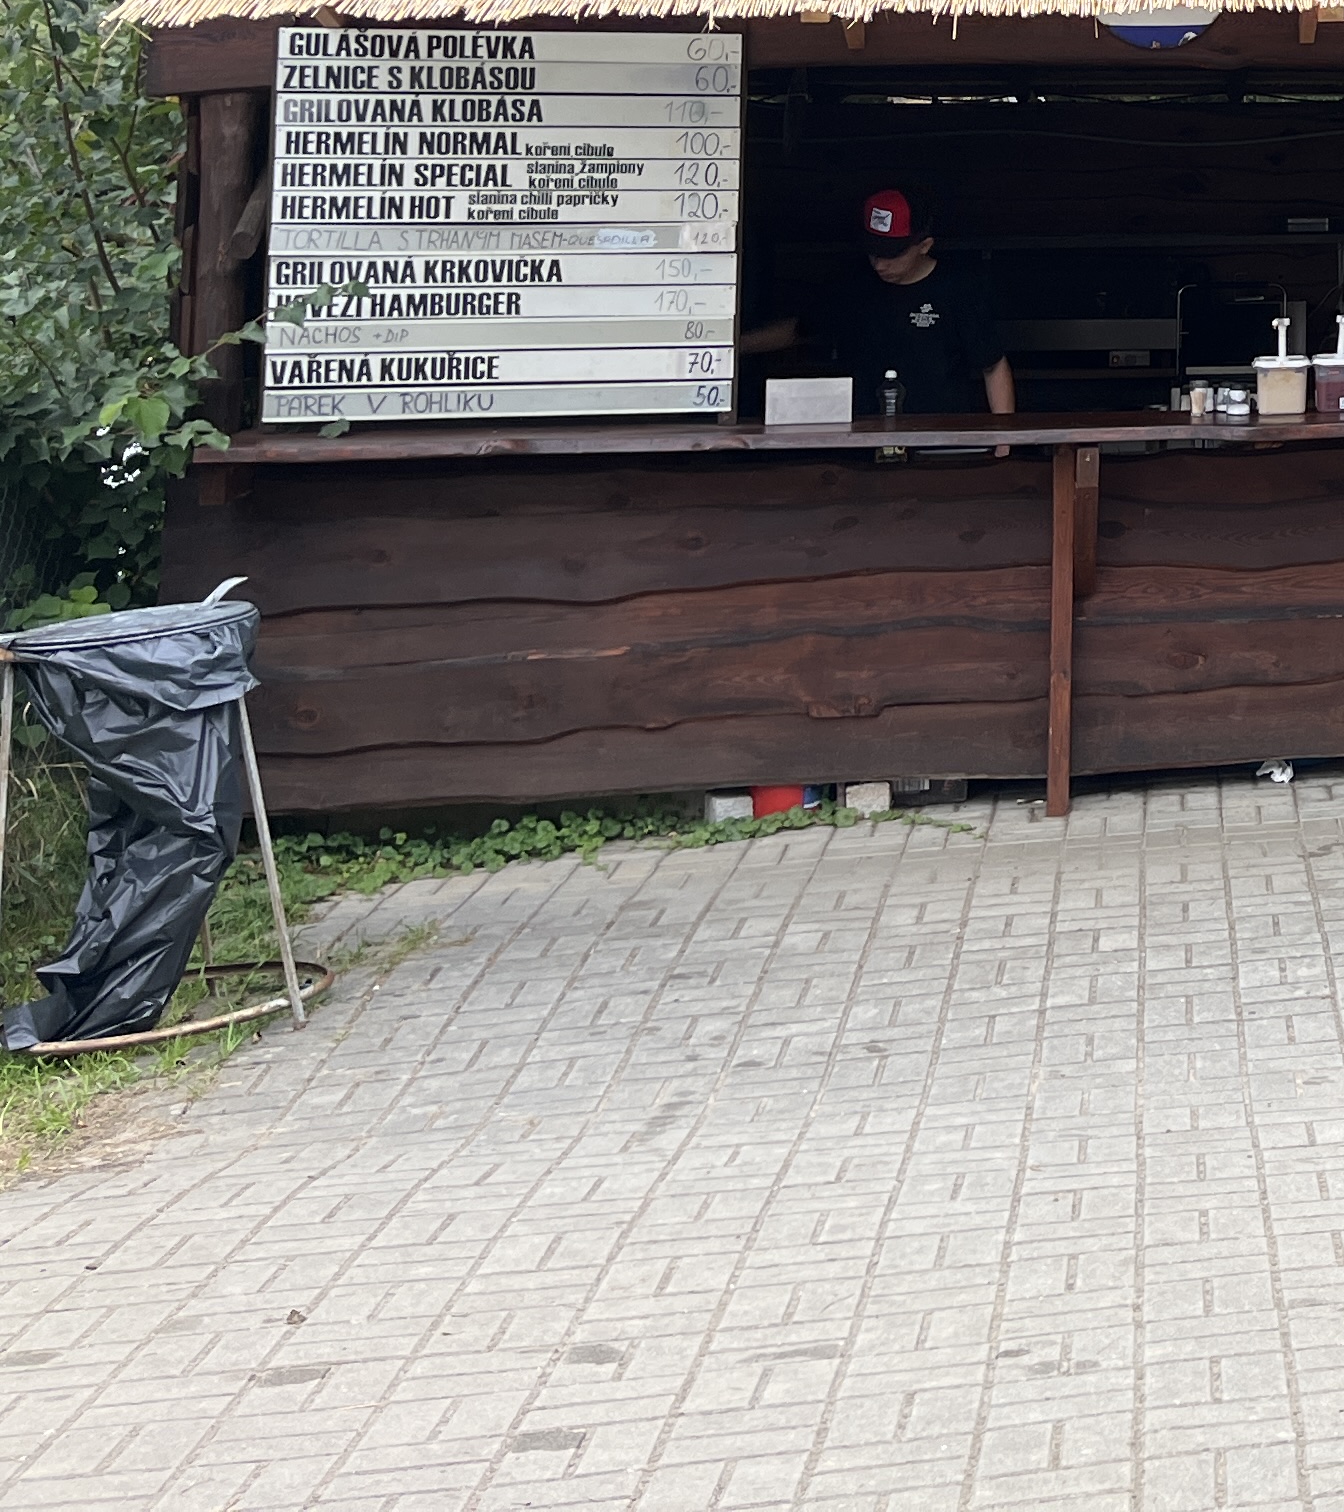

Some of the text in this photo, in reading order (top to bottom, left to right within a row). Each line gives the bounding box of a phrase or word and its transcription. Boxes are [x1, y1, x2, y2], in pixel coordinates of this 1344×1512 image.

[289, 28, 421, 59] GULÁŠOVÁ
[427, 31, 535, 60] POLÉVKA
[283, 65, 380, 89] ZELNICE
[388, 65, 402, 89] S
[409, 62, 536, 90] KLOBÁSOU
[283, 94, 424, 123] GRILOVANÁ
[432, 95, 543, 123] KLOBÁSA
[285, 127, 409, 155] HERMELÍN
[418, 131, 522, 155] NORMAL
[575, 143, 614, 157] cibule
[281, 158, 405, 187] HERMELÍN
[414, 163, 512, 188] SPECIAL
[578, 175, 618, 189] cibule
[280, 191, 404, 220] HERMELÍN
[409, 195, 455, 220] HOT
[521, 191, 552, 205] chilli
[557, 191, 619, 207] papričky
[519, 207, 559, 220] cibule
[278, 228, 382, 251] TORTILLA
[275, 255, 417, 285] GRILOVANÁ
[424, 255, 562, 285] KRKOVIČKA
[370, 292, 521, 318] HAMBURGER
[280, 326, 362, 347] NACHOS
[270, 352, 373, 385] VAŘENÁ
[380, 351, 500, 382] KUKUŘICE
[367, 394, 388, 415] V
